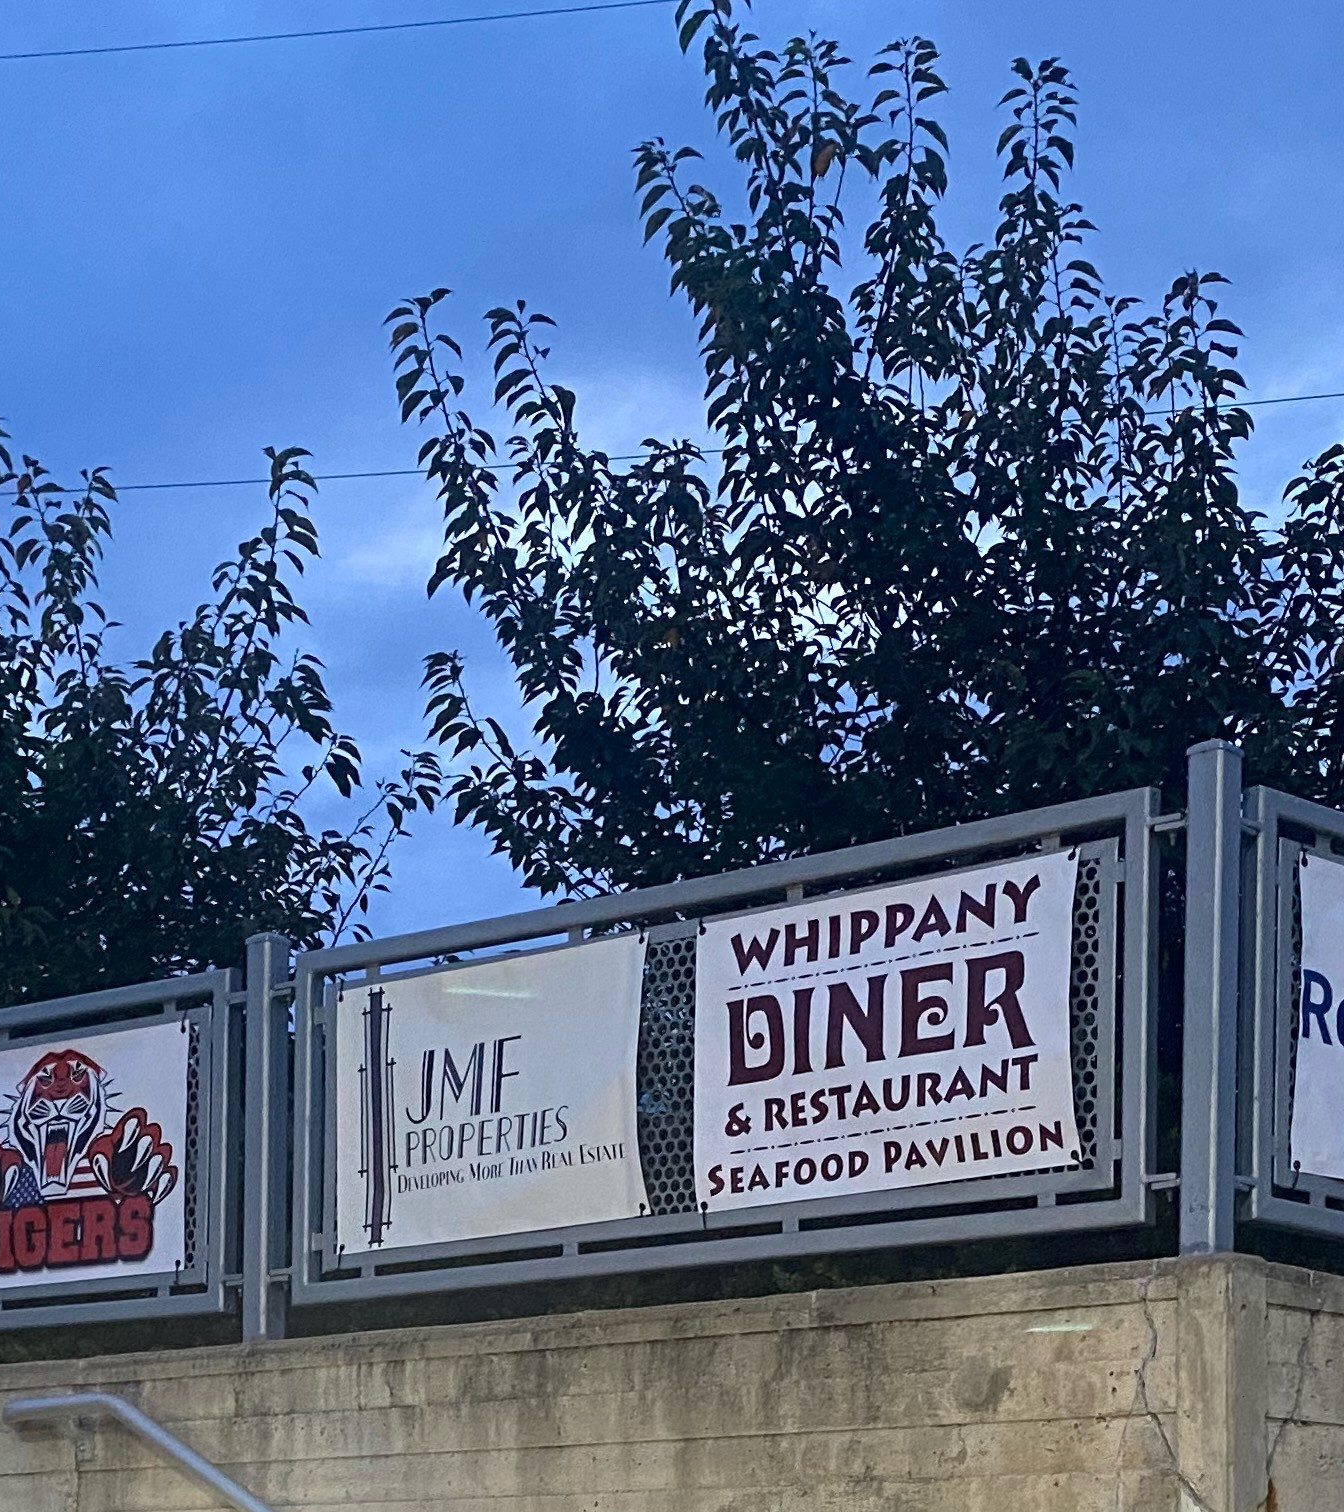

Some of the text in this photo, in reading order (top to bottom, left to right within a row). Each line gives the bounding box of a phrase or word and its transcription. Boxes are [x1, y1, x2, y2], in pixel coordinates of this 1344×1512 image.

[730, 873, 1042, 977] WHIPPANY
[725, 949, 1037, 1087] DINER
[406, 1035, 522, 1124] JMF
[724, 1053, 1039, 1138] & RESTAURANT
[406, 1105, 569, 1168] PROPERTIES
[707, 1119, 1065, 1197] SEAFOOD PAVILION
